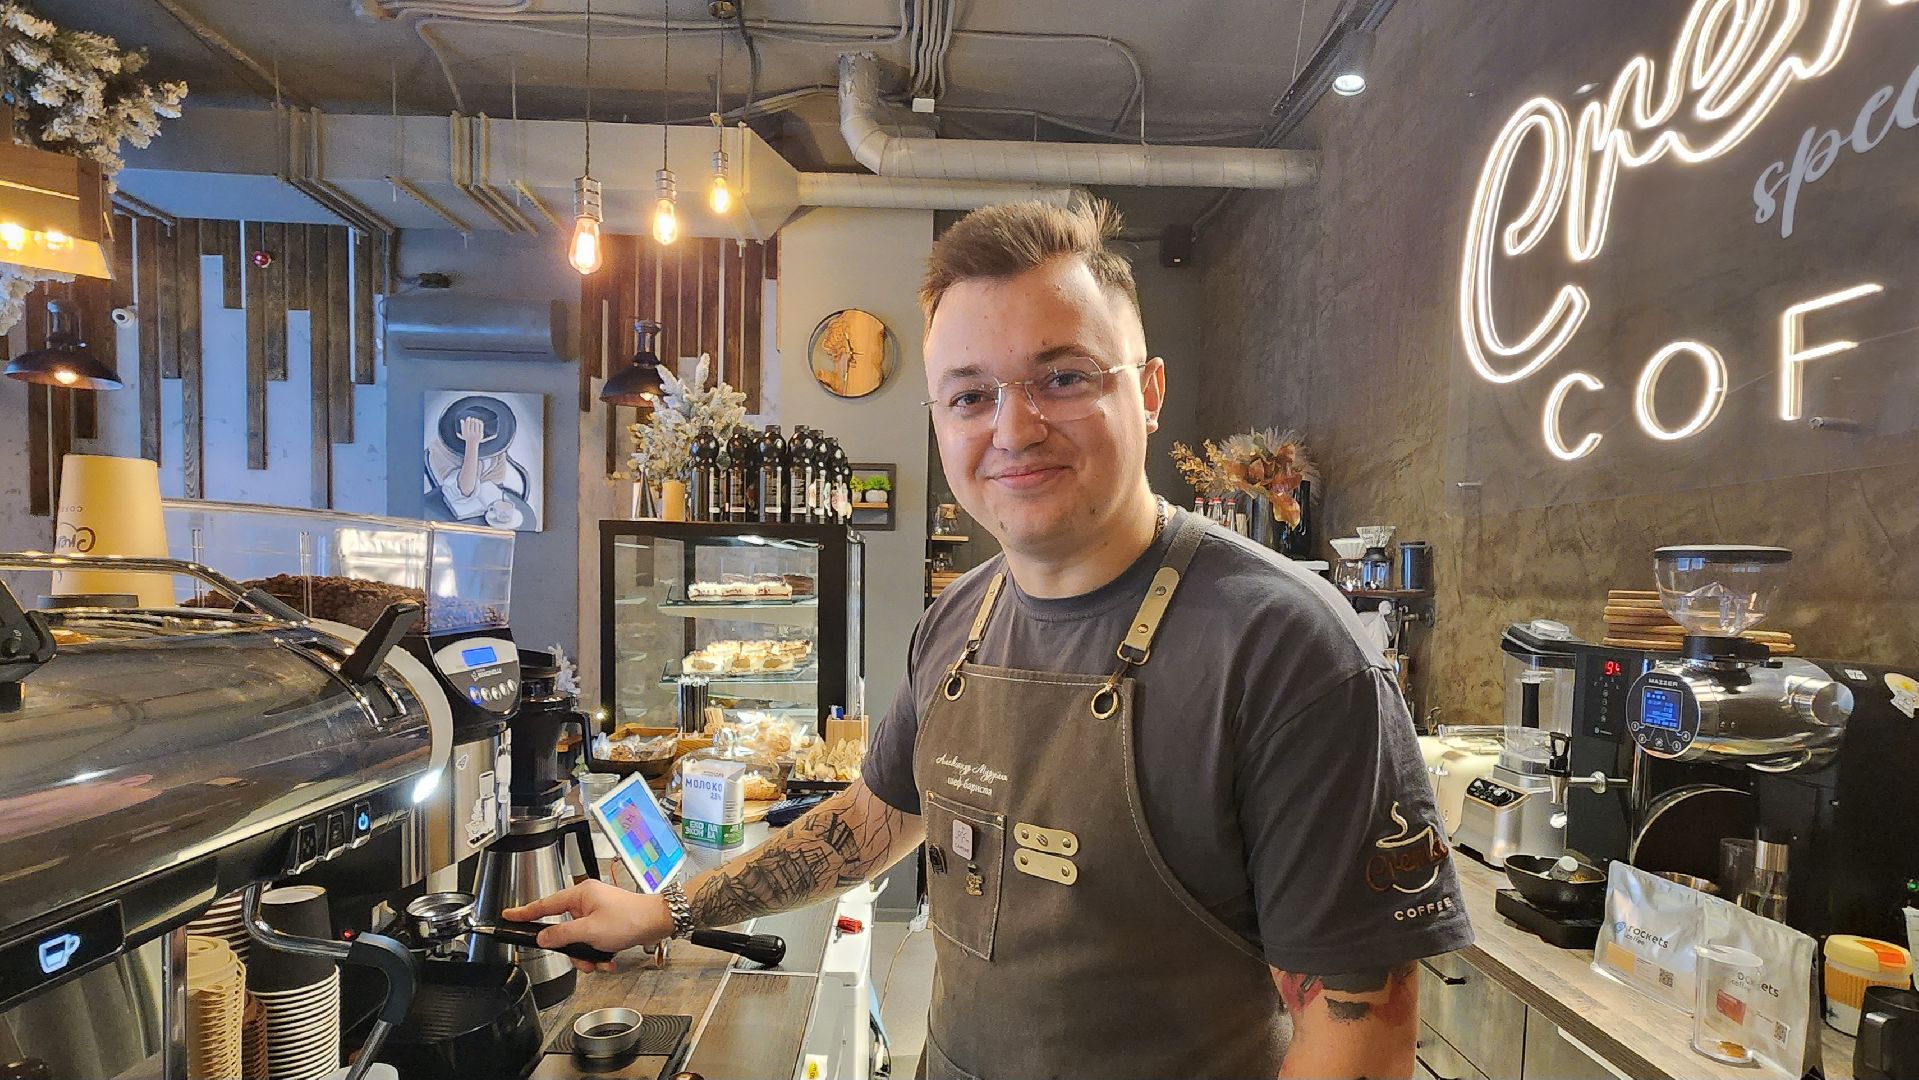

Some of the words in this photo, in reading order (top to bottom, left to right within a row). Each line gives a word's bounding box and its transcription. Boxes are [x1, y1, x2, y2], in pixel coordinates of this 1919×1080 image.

[1648, 677, 1678, 687] MAZZER
[685, 777, 723, 792] МОЛОКО
[1394, 896, 1453, 921] COFFEE
[1628, 925, 1668, 949] rockets
